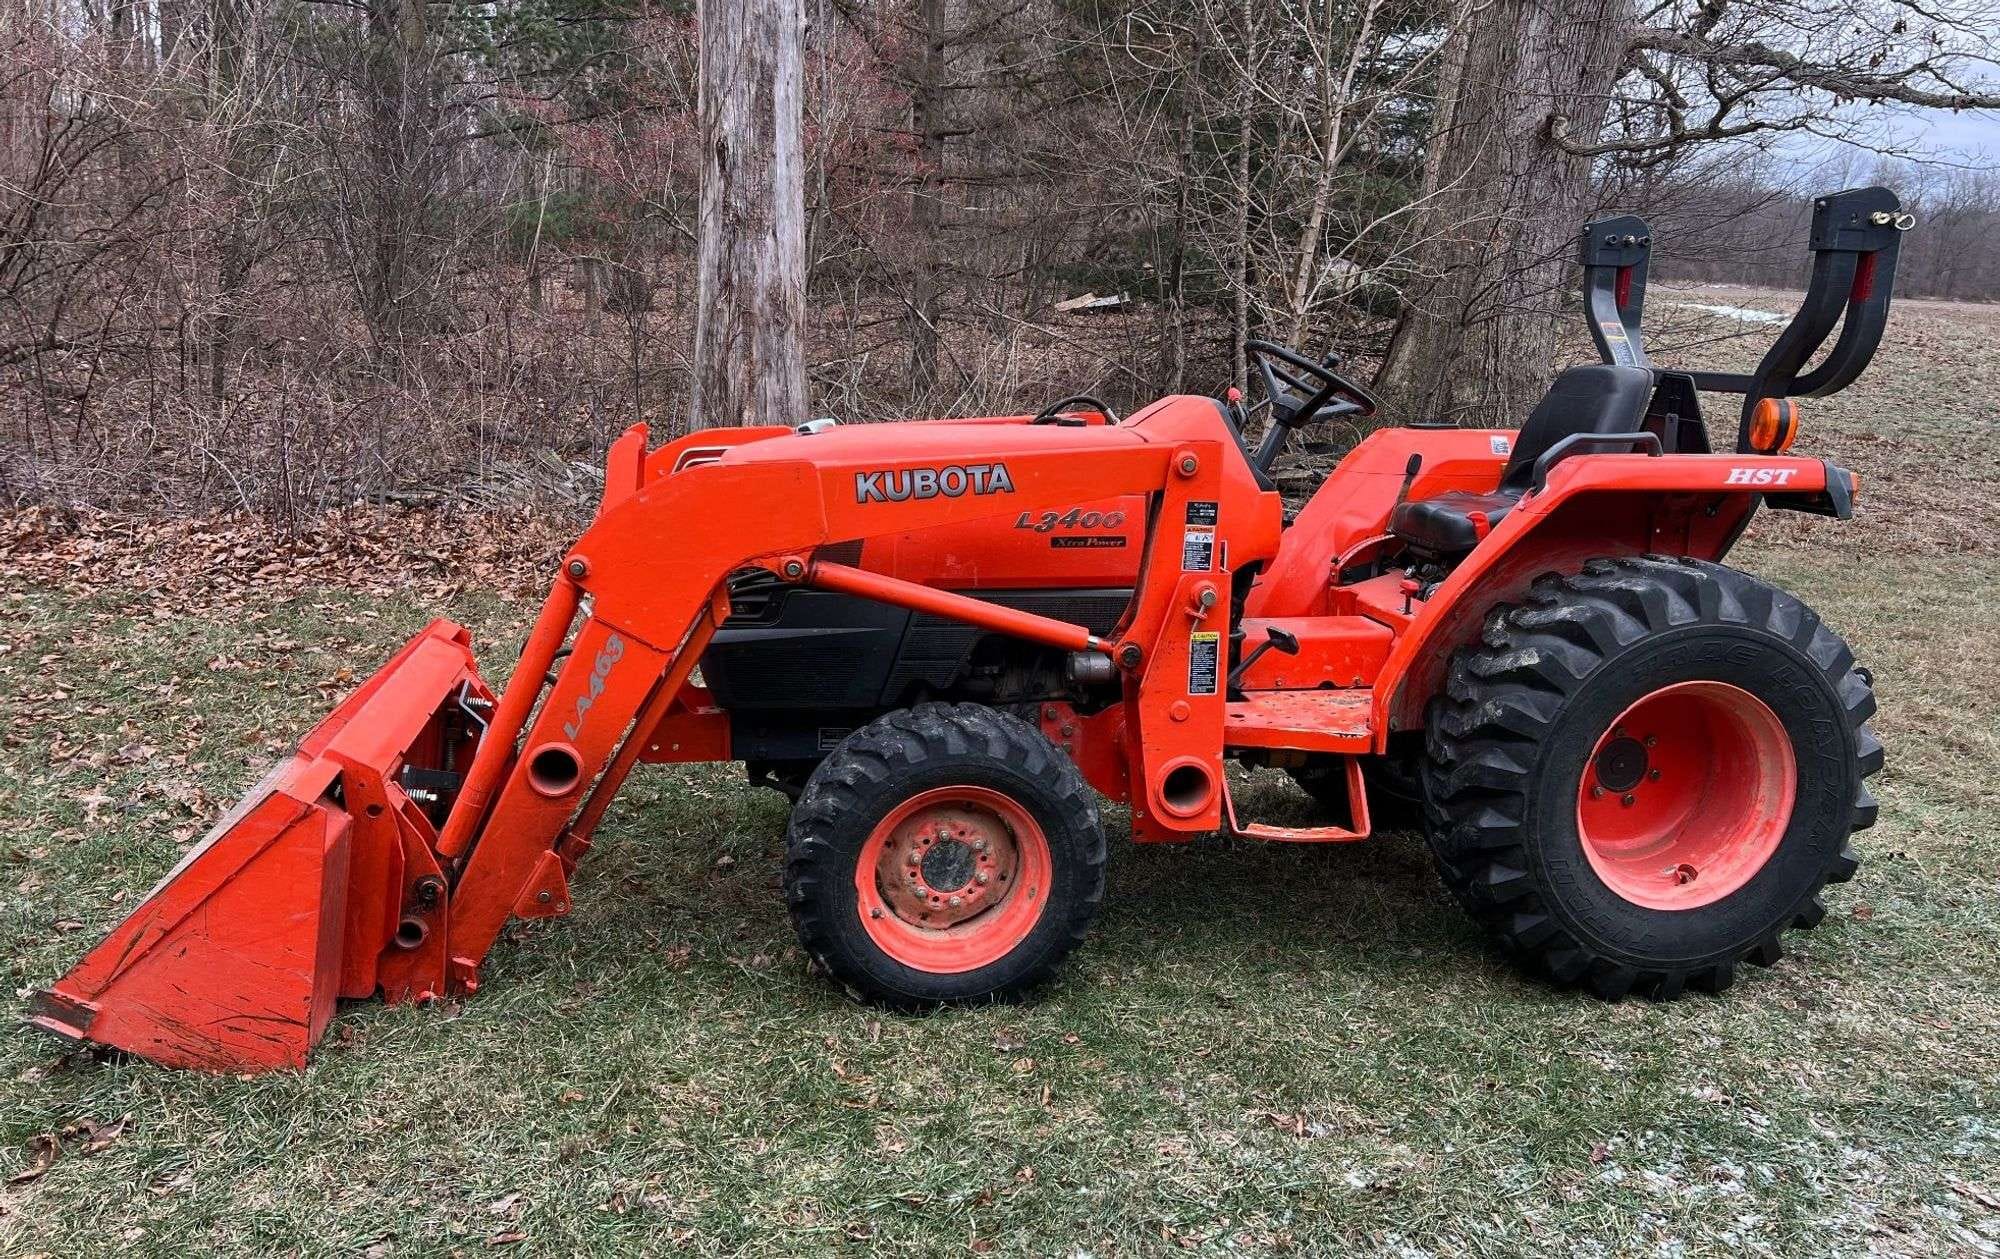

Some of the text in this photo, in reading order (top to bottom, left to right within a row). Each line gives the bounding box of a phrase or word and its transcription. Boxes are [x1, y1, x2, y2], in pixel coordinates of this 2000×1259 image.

[855, 463, 1014, 503] KUBOTA
[1724, 468, 1798, 485] HST
[1014, 508, 1127, 533] L3400
[1086, 537, 1124, 547] Power
[563, 633, 625, 741] LA463
